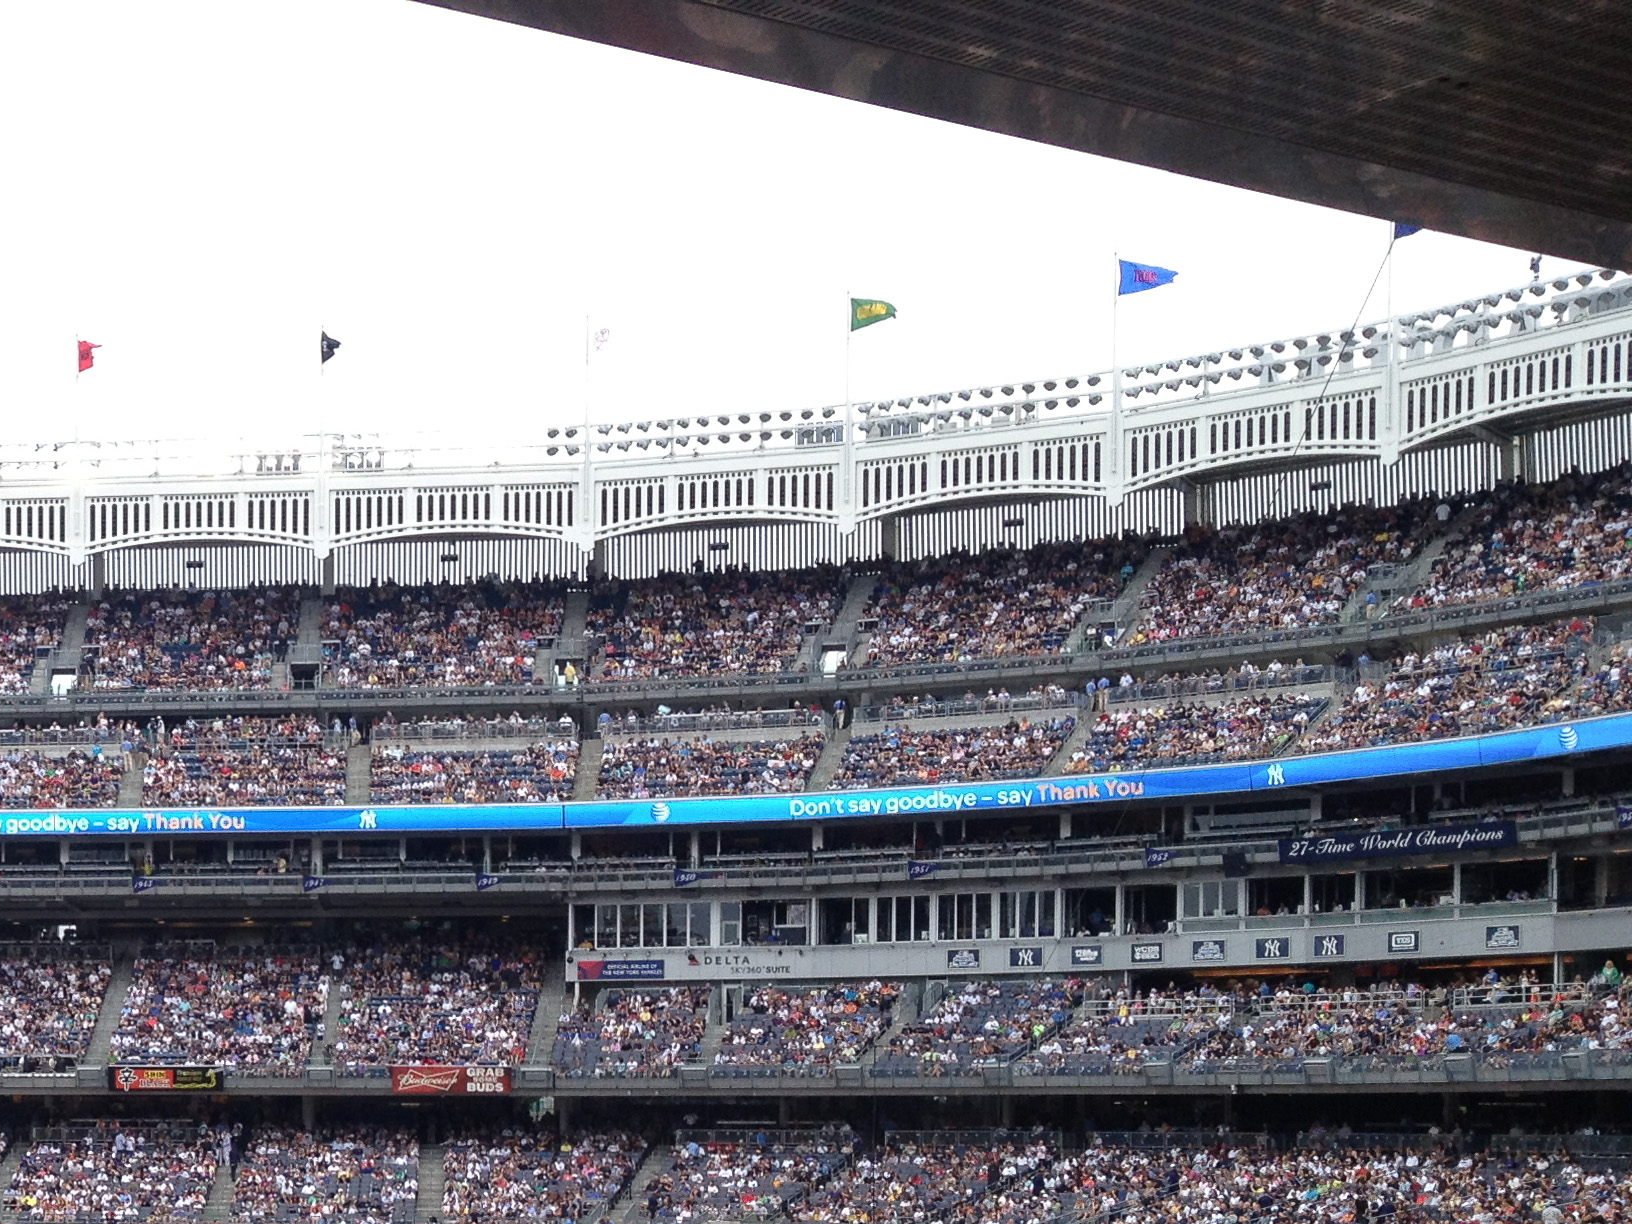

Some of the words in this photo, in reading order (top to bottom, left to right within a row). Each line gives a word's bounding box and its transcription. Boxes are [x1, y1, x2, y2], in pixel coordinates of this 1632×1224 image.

[789, 798, 844, 816] Don't
[848, 797, 883, 814] say
[885, 790, 977, 814] goodbye
[997, 789, 1033, 806] say
[1036, 780, 1101, 802] Thank
[1104, 779, 1145, 797] You
[5, 815, 89, 834] goodbye
[107, 817, 140, 833] say
[143, 813, 204, 830] Thank
[207, 813, 245, 830] You
[1288, 837, 1355, 857] 27-Time
[1360, 830, 1415, 852] World
[1416, 827, 1505, 849] Champions
[704, 956, 750, 965] DELTA
[466, 1067, 504, 1077] GRAB
[397, 1073, 458, 1086] Budweiser
[466, 1082, 504, 1092] BUDS
